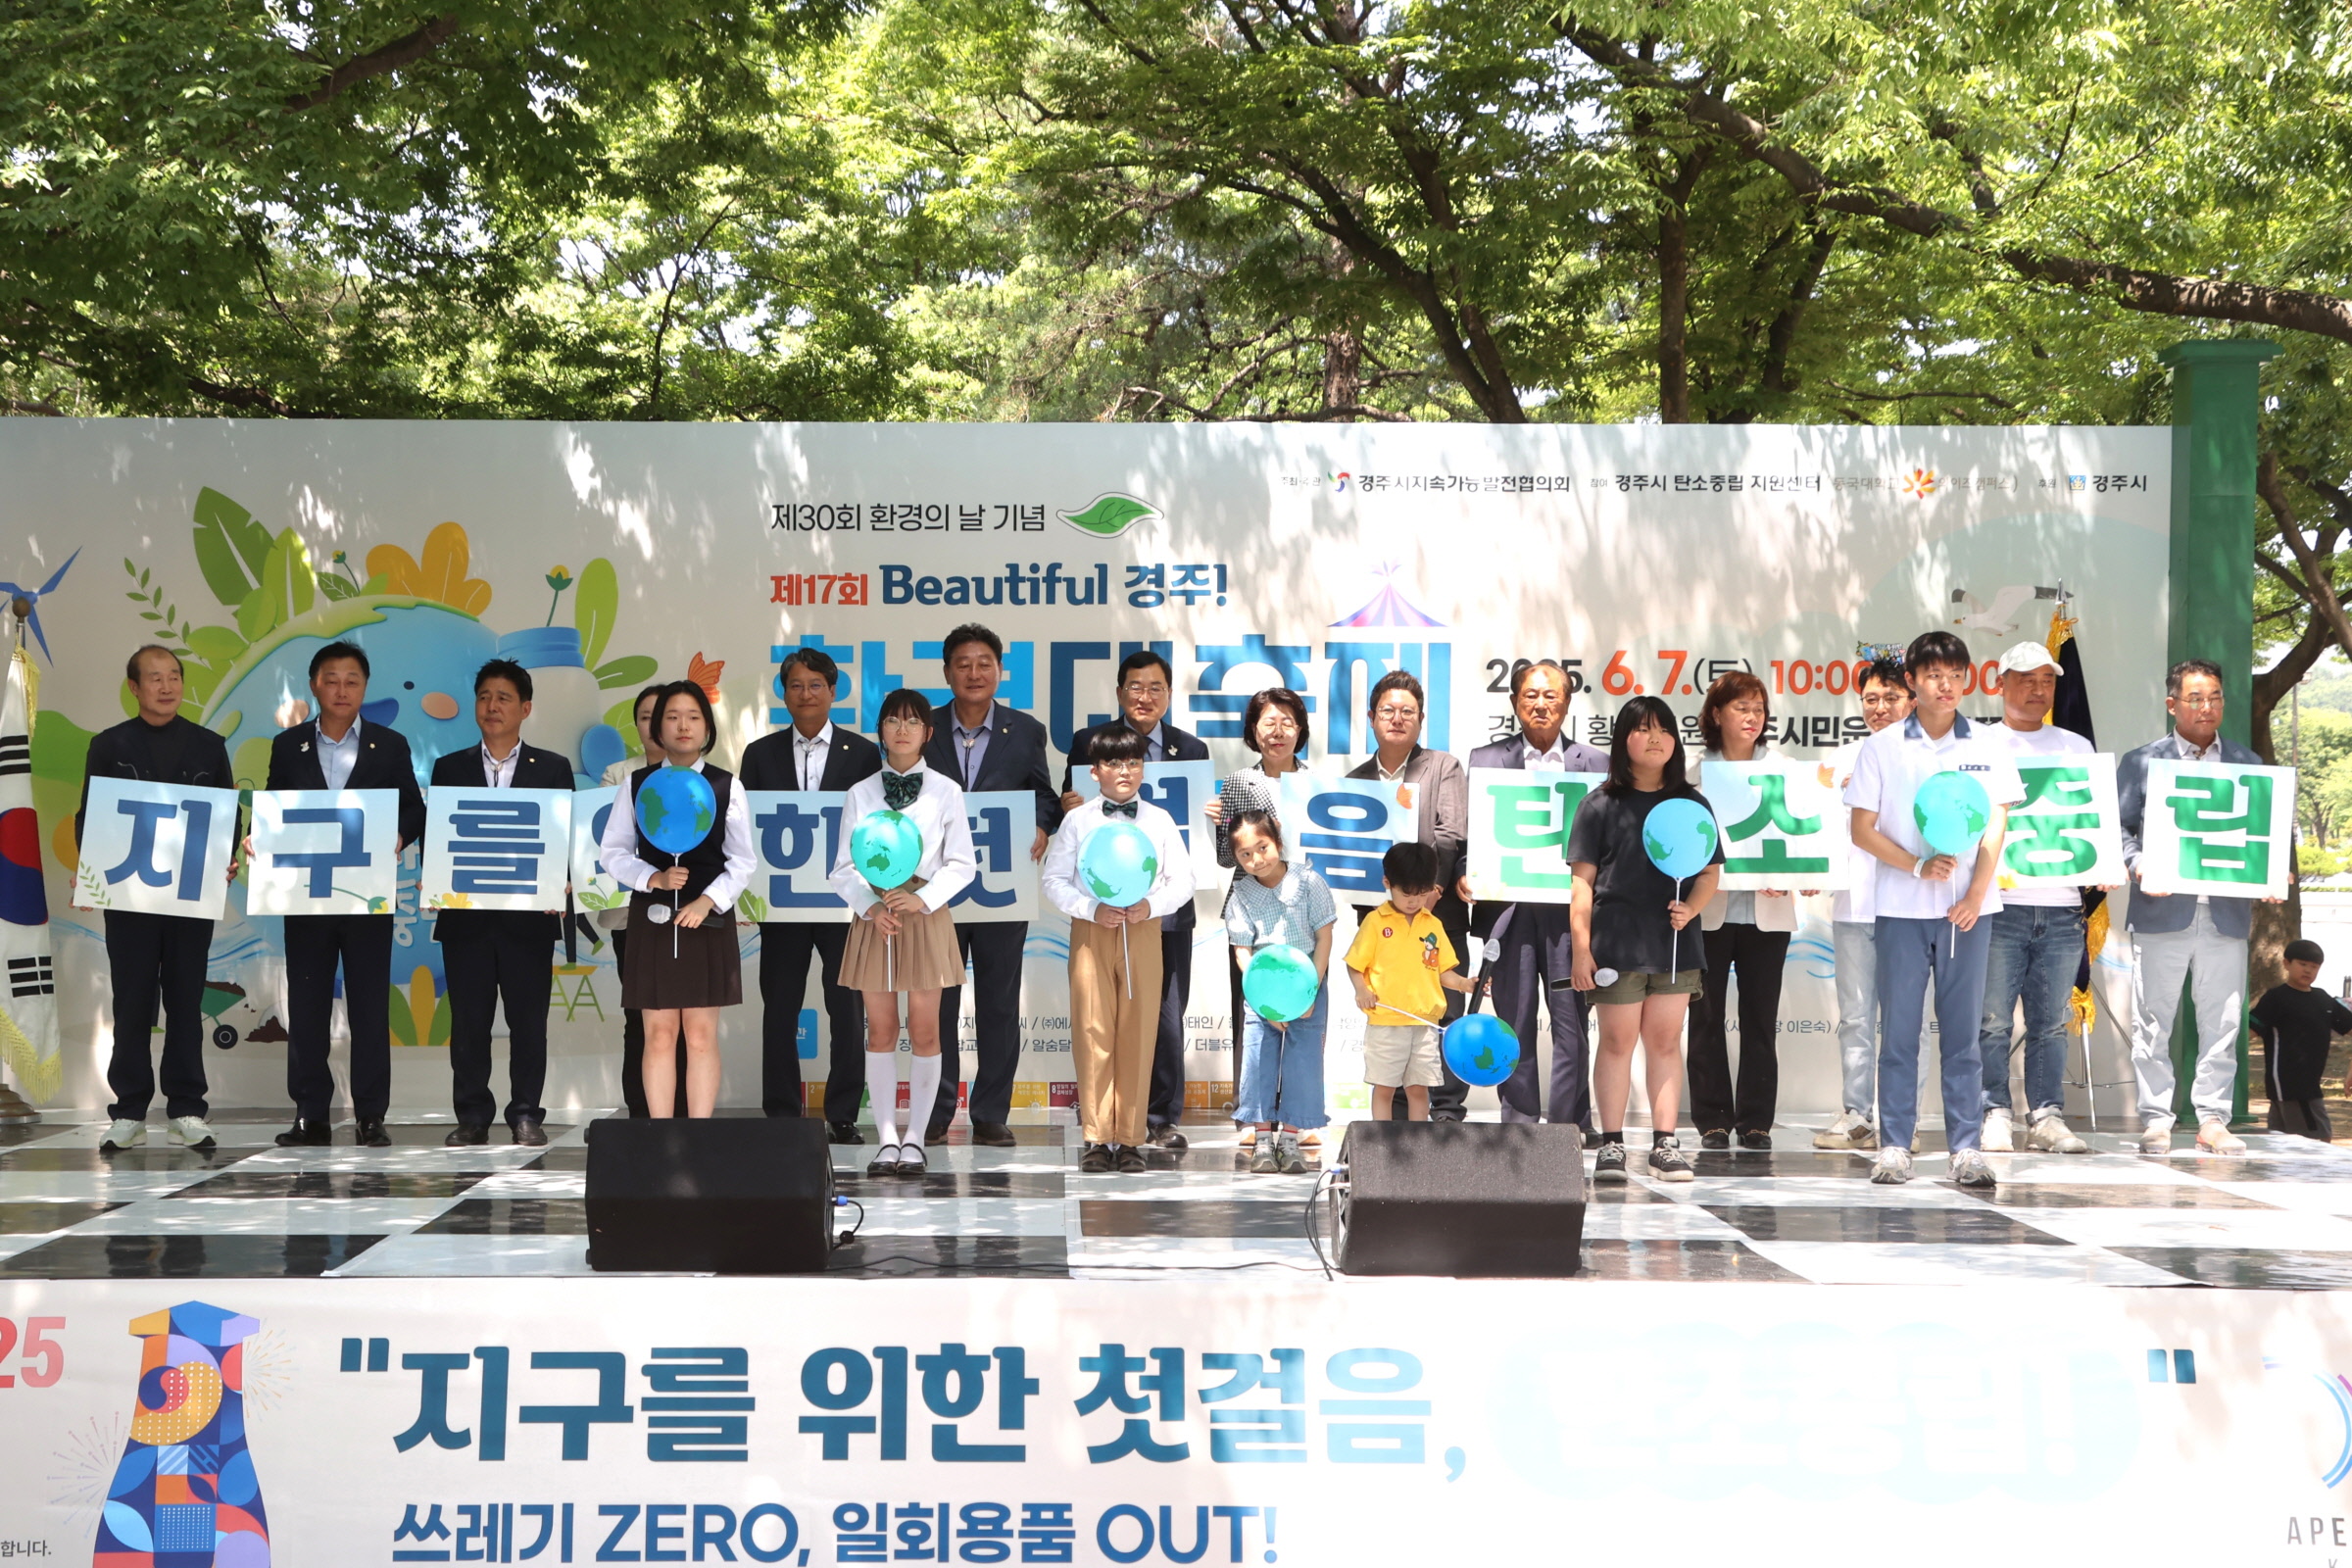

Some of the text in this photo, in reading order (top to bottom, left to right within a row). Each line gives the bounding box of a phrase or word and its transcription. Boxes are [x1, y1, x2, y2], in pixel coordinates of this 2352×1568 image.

[1358, 474, 1570, 492] 경주시지속가능발전협의회
[1590, 477, 1608, 488] 참여
[1615, 474, 1821, 492] 경주시 탄소중립 지원센터
[2092, 474, 2147, 493] 경주시
[771, 503, 1045, 532] 제30회 환경의 날 기념
[769, 563, 1228, 609] 제17회 Beautiful 경주!
[1486, 658, 1592, 694] 25.
[1184, 1015, 1214, 1030] 태인
[1032, 1039, 1072, 1053] 알숨달
[1195, 1038, 1234, 1053] 더블유
[799, 1343, 1040, 1463] 위한
[1073, 1343, 1467, 1483] 첫걸음,
[392, 1502, 1278, 1567] 쓰레기 ZERO, 일회용품 OUT!
[0, 1540, 52, 1557] 합니다.
